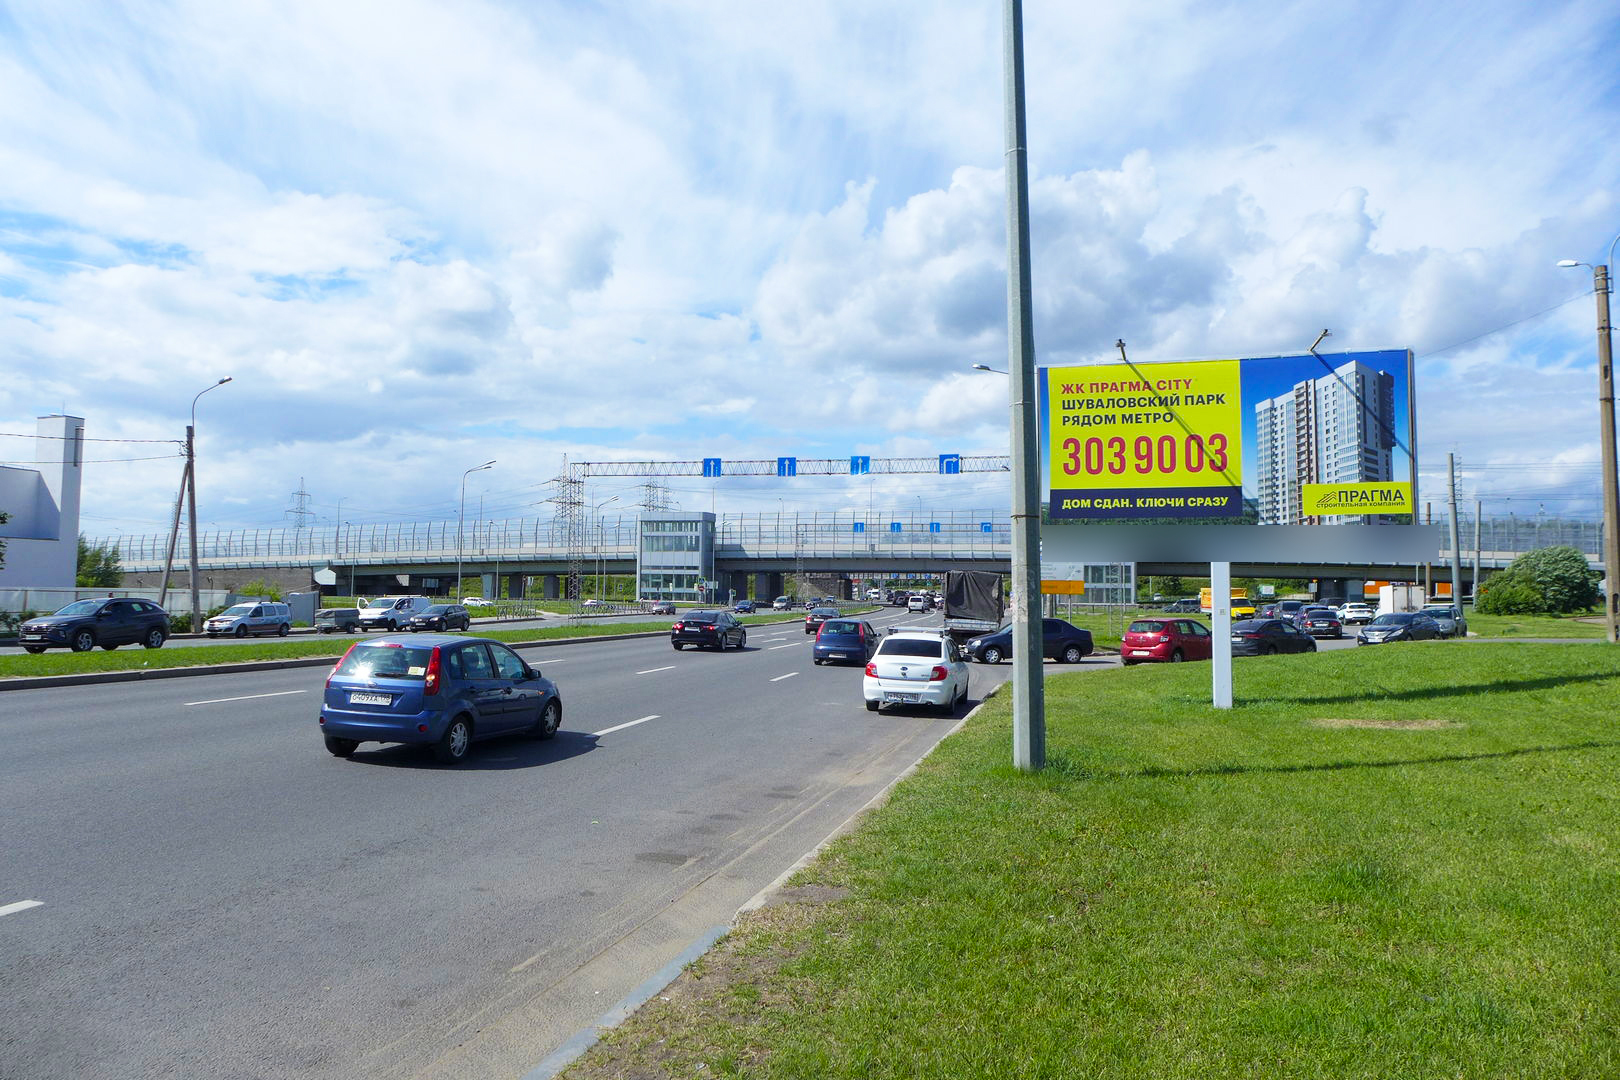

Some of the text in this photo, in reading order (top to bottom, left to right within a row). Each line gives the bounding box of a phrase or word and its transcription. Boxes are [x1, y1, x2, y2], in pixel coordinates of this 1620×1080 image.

[1061, 378, 1192, 394] ЖК ПРАГМА CITY
[1062, 393, 1226, 410] ШУВАЛОВСКИЙ ПАРК
[1062, 412, 1174, 427] РЯДОМ МЕТРО
[1062, 496, 1229, 510] ДОМ СДАН. КЛЮЧИ СРАЗУ
[1338, 489, 1405, 503] ПРАГМА
[1316, 500, 1406, 509] строительная компания
